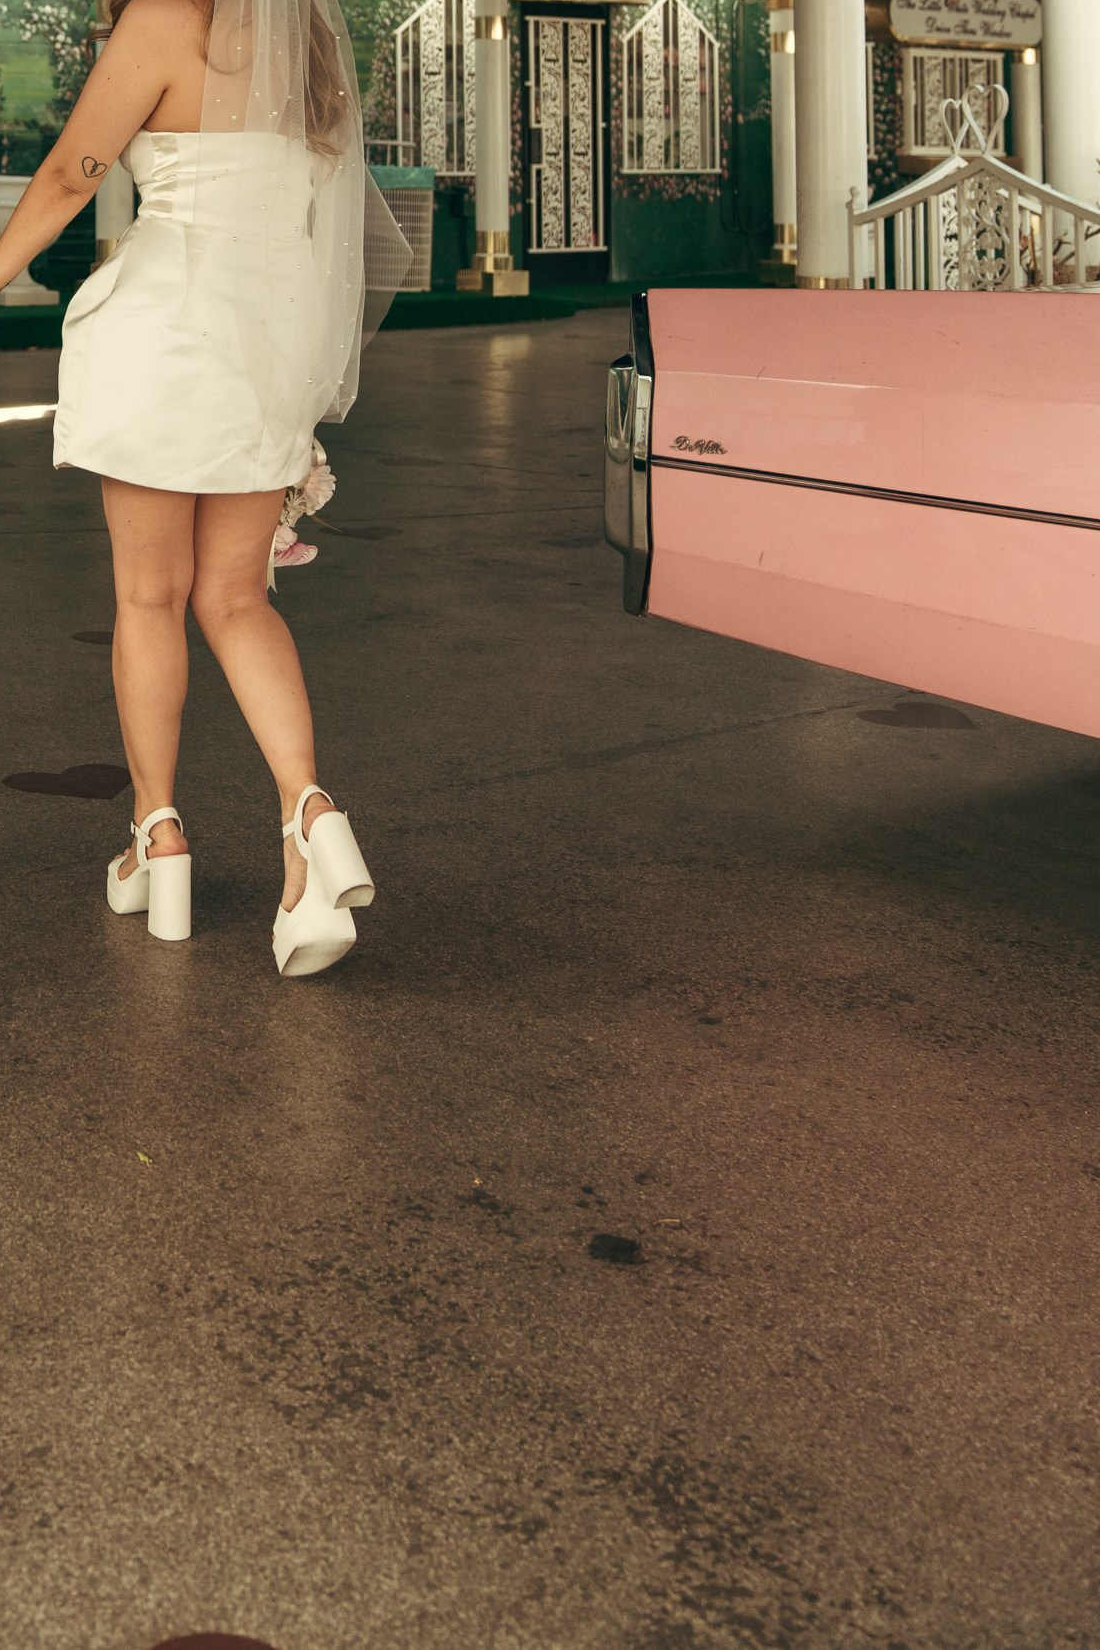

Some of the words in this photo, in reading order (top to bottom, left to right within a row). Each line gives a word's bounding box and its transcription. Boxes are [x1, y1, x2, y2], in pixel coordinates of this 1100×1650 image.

[1008, 0, 1036, 24] Chapel
[925, 15, 951, 34] Drive
[979, 20, 1013, 38] Window
